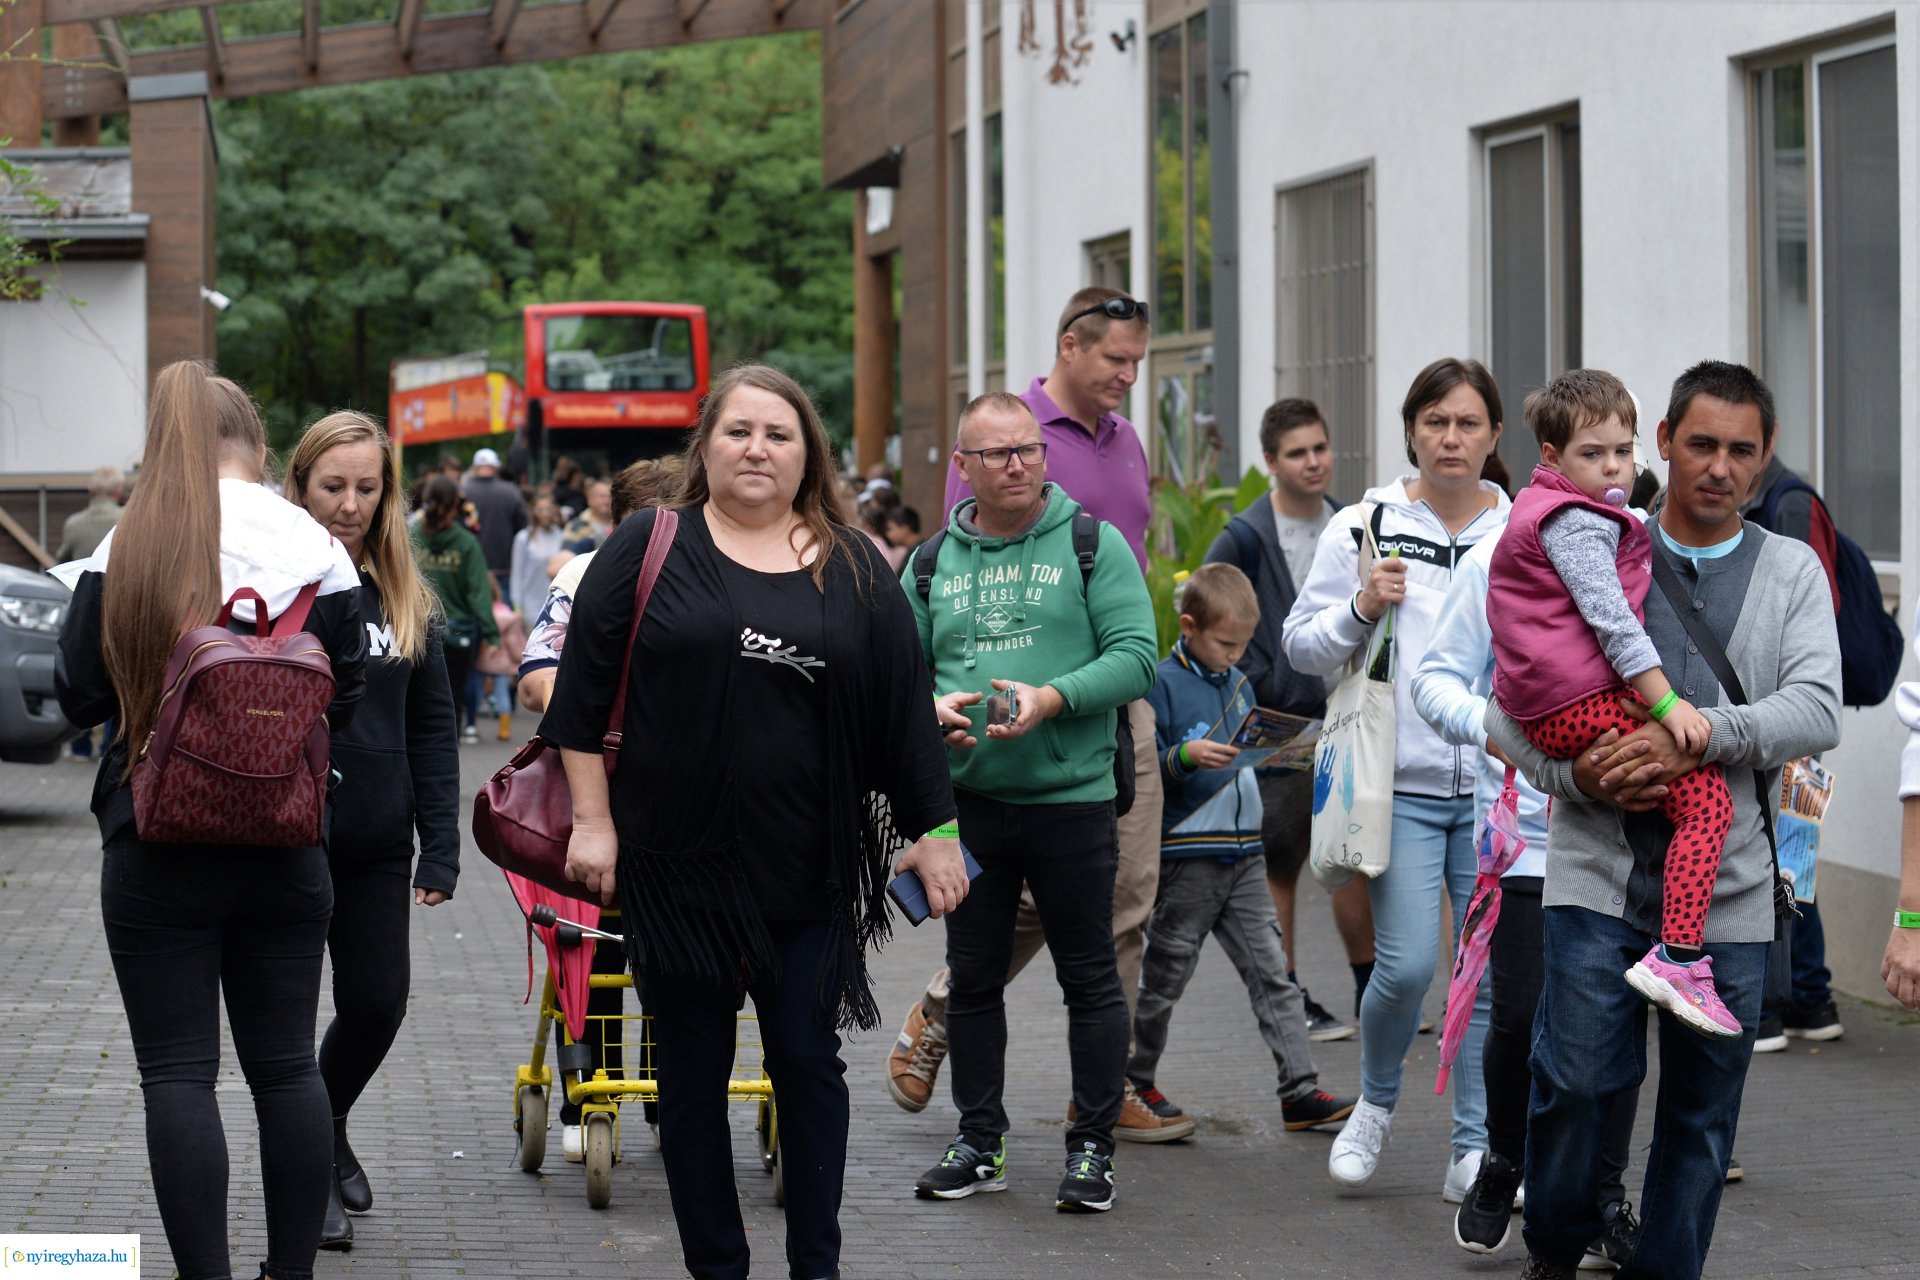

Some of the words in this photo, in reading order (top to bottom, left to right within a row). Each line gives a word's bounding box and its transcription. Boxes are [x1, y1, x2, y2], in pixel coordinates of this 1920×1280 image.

[943, 563, 1063, 597] ROCKHAMTON
[954, 587, 1042, 610] QUENSLND
[962, 636, 993, 652] WN
[996, 634, 1034, 652] UNDER
